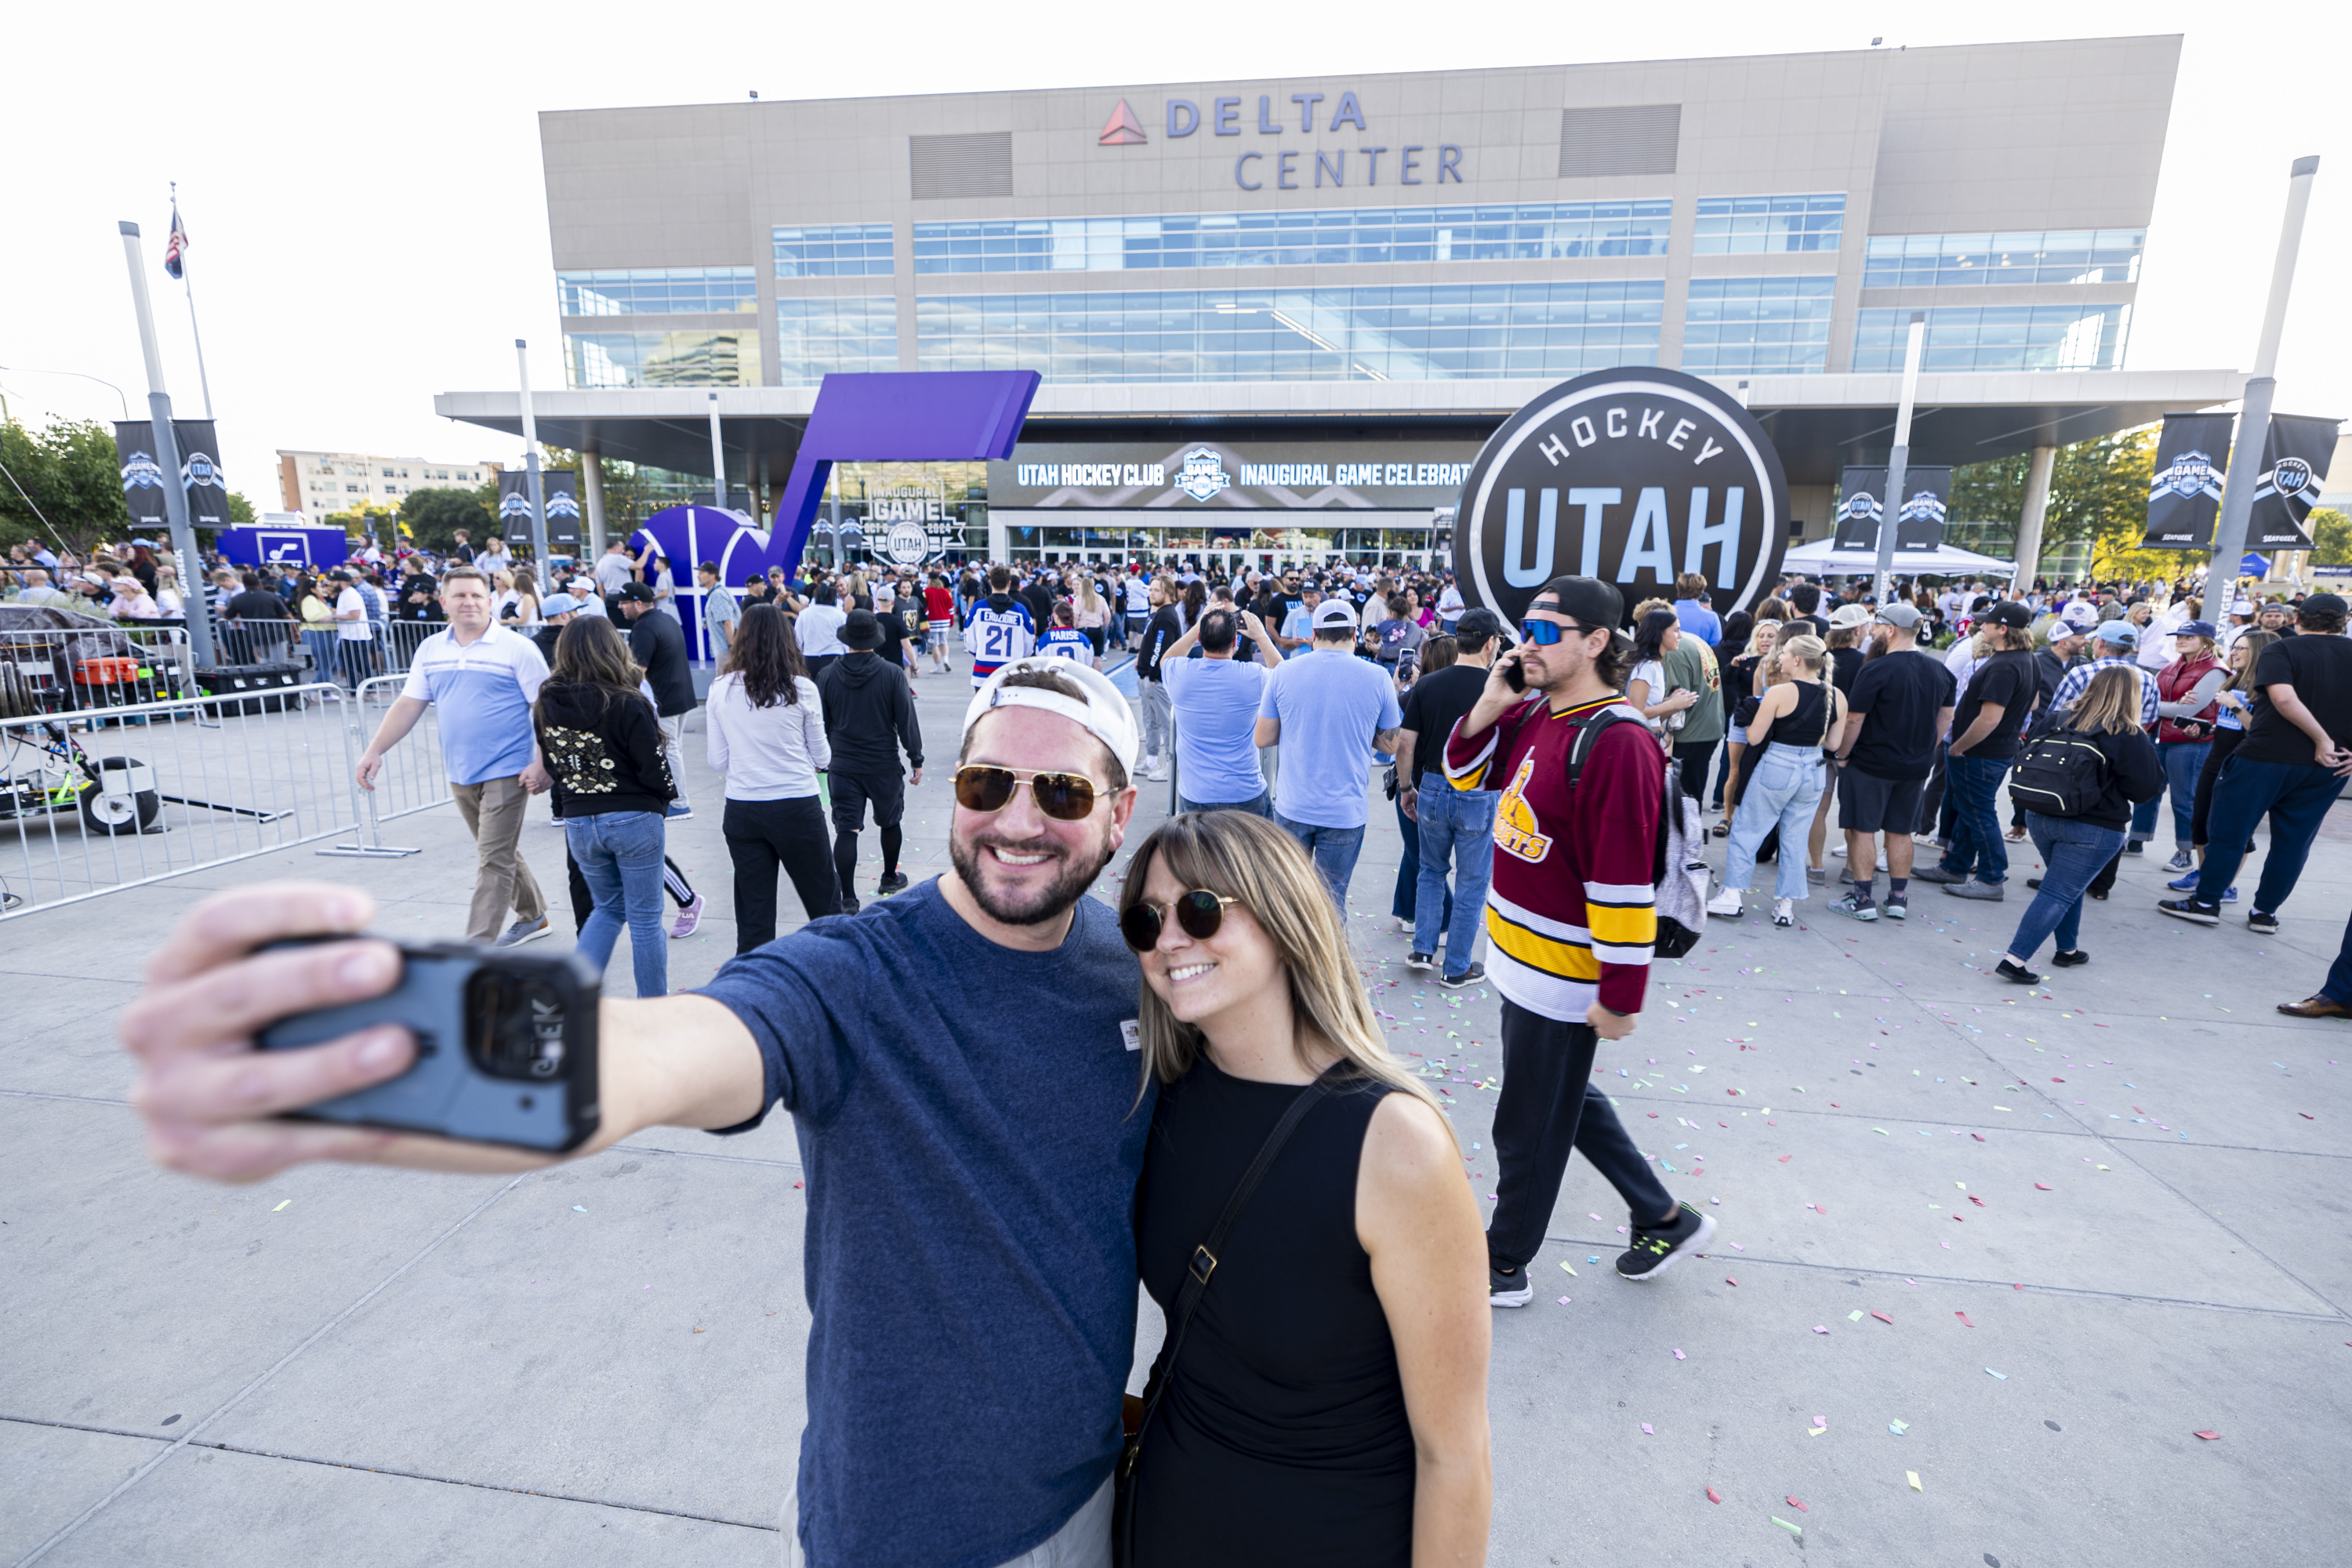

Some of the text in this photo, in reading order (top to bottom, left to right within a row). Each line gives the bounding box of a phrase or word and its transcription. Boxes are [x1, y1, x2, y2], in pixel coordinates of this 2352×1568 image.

[1166, 91, 1366, 139] DELTA
[1235, 143, 1464, 191] CENTER
[1538, 407, 1724, 466] HOCKEY
[1018, 463, 1165, 486] UTAH HOCKEY CLUB
[1240, 463, 1333, 485] INAUGURAL
[1335, 463, 1383, 485] GAME
[2174, 465, 2208, 475] GAME
[2278, 470, 2306, 488] TAH
[873, 486, 939, 498] INAUGURAL
[874, 498, 941, 521] GAME
[864, 523, 882, 534] OCT
[927, 523, 951, 534] 2024
[1503, 486, 1745, 590] UTAH
[2263, 534, 2298, 543] SEATGEEK
[894, 538, 921, 552] UTAH
[173, 548, 192, 598] SEATGEEK
[984, 612, 1018, 625] ERUZIONE
[2214, 578, 2238, 641] SEATGEEK
[985, 625, 1012, 657] 21
[1050, 630, 1080, 641] PARISE
[1922, 621, 1932, 641] 9
